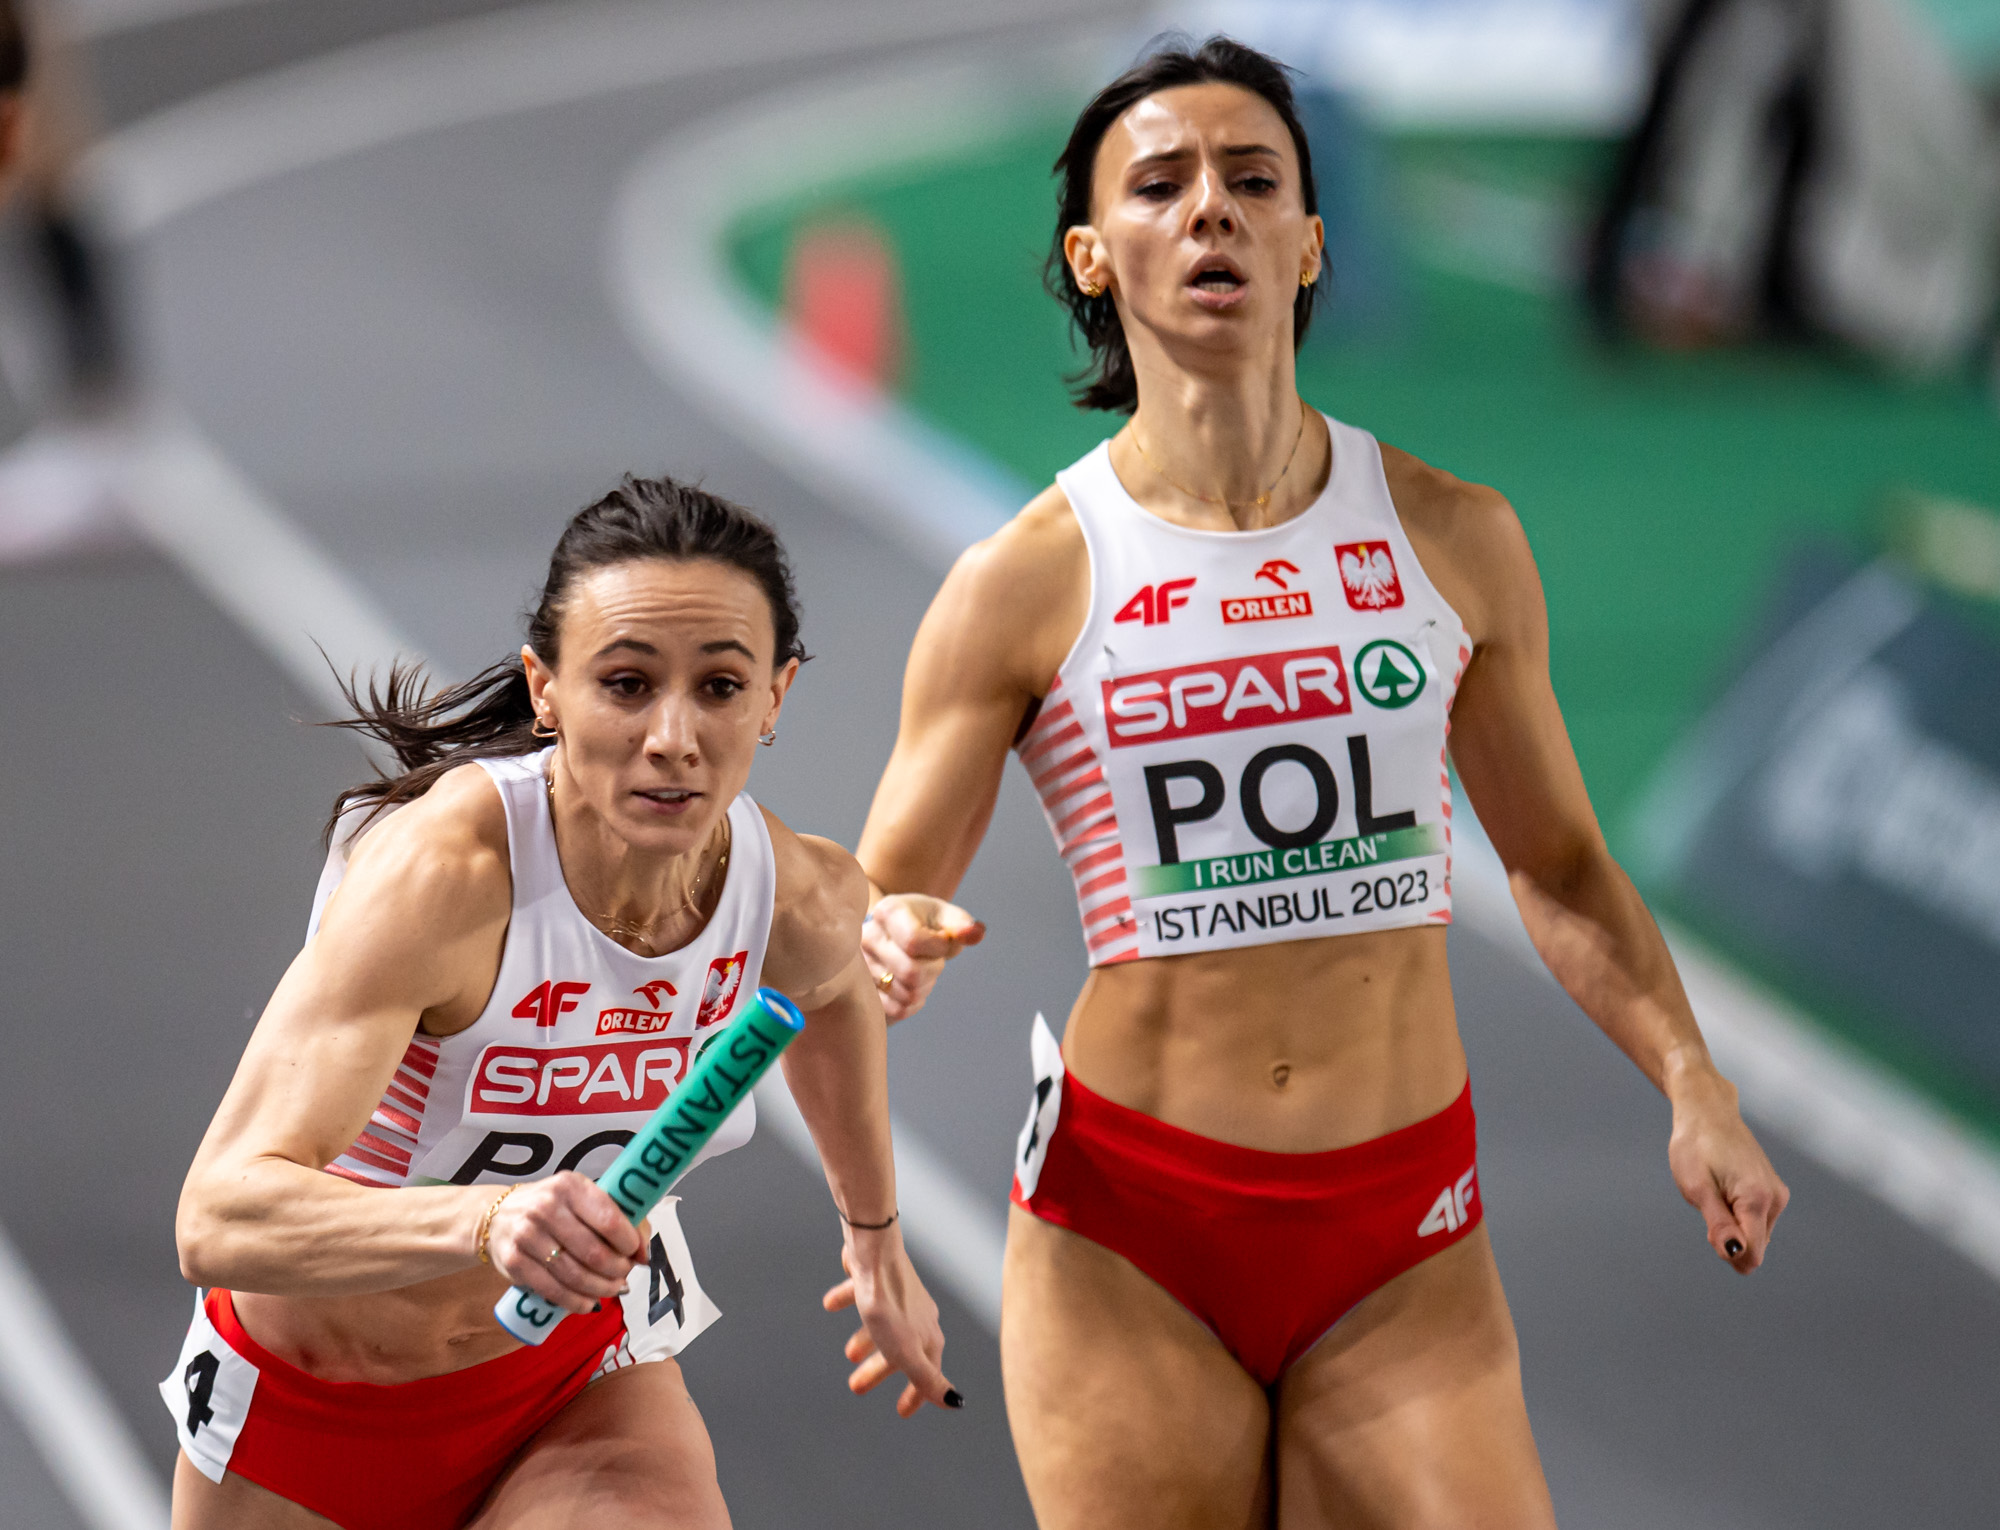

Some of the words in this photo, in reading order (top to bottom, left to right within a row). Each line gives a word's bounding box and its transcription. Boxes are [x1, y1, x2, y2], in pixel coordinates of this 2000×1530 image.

[1113, 577, 1197, 627] 4F
[1226, 597, 1307, 622] ORLEN
[1109, 655, 1345, 738] SPAR
[1143, 734, 1417, 866] POL
[1210, 853, 1274, 885] RUN
[1155, 888, 1344, 942] ISTANBUL
[1350, 870, 1429, 915] 2023
[511, 979, 591, 1028] 4F
[600, 1008, 668, 1032] ORLEN
[479, 1048, 682, 1106] SPAR
[1417, 1165, 1474, 1238] 4F
[648, 1231, 685, 1331] 4
[184, 1350, 220, 1439] 4
